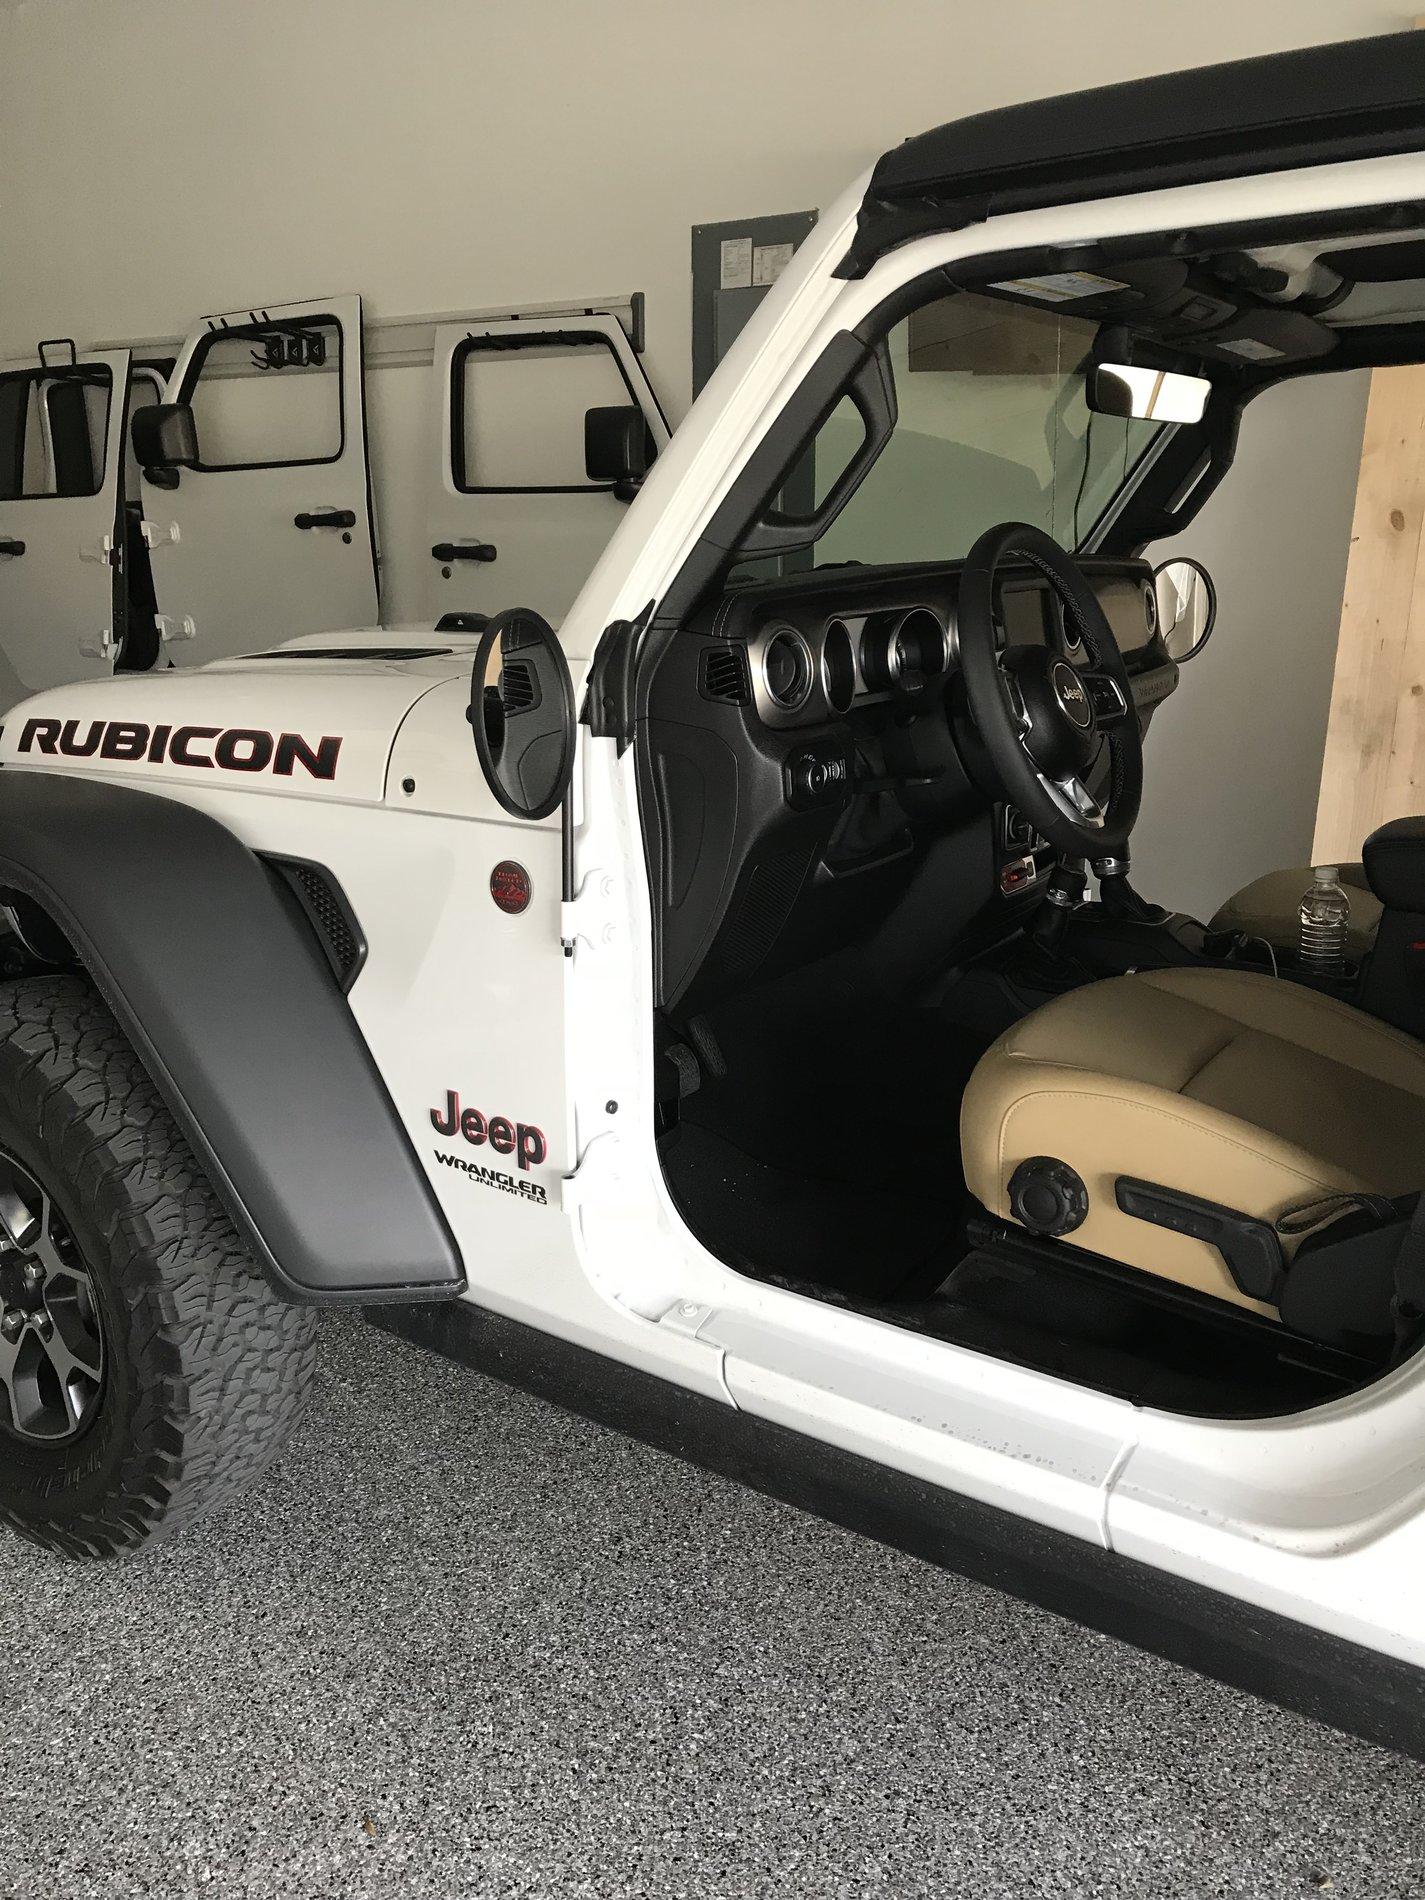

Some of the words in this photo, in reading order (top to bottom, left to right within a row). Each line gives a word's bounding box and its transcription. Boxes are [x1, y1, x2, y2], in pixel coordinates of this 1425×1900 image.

[1063, 685, 1084, 703] Jeep
[17, 718, 343, 781] RUBICON
[430, 1089, 547, 1171] Jeep
[433, 1149, 547, 1199] WRANGLER
[468, 1173, 548, 1205] UNLIMITED
